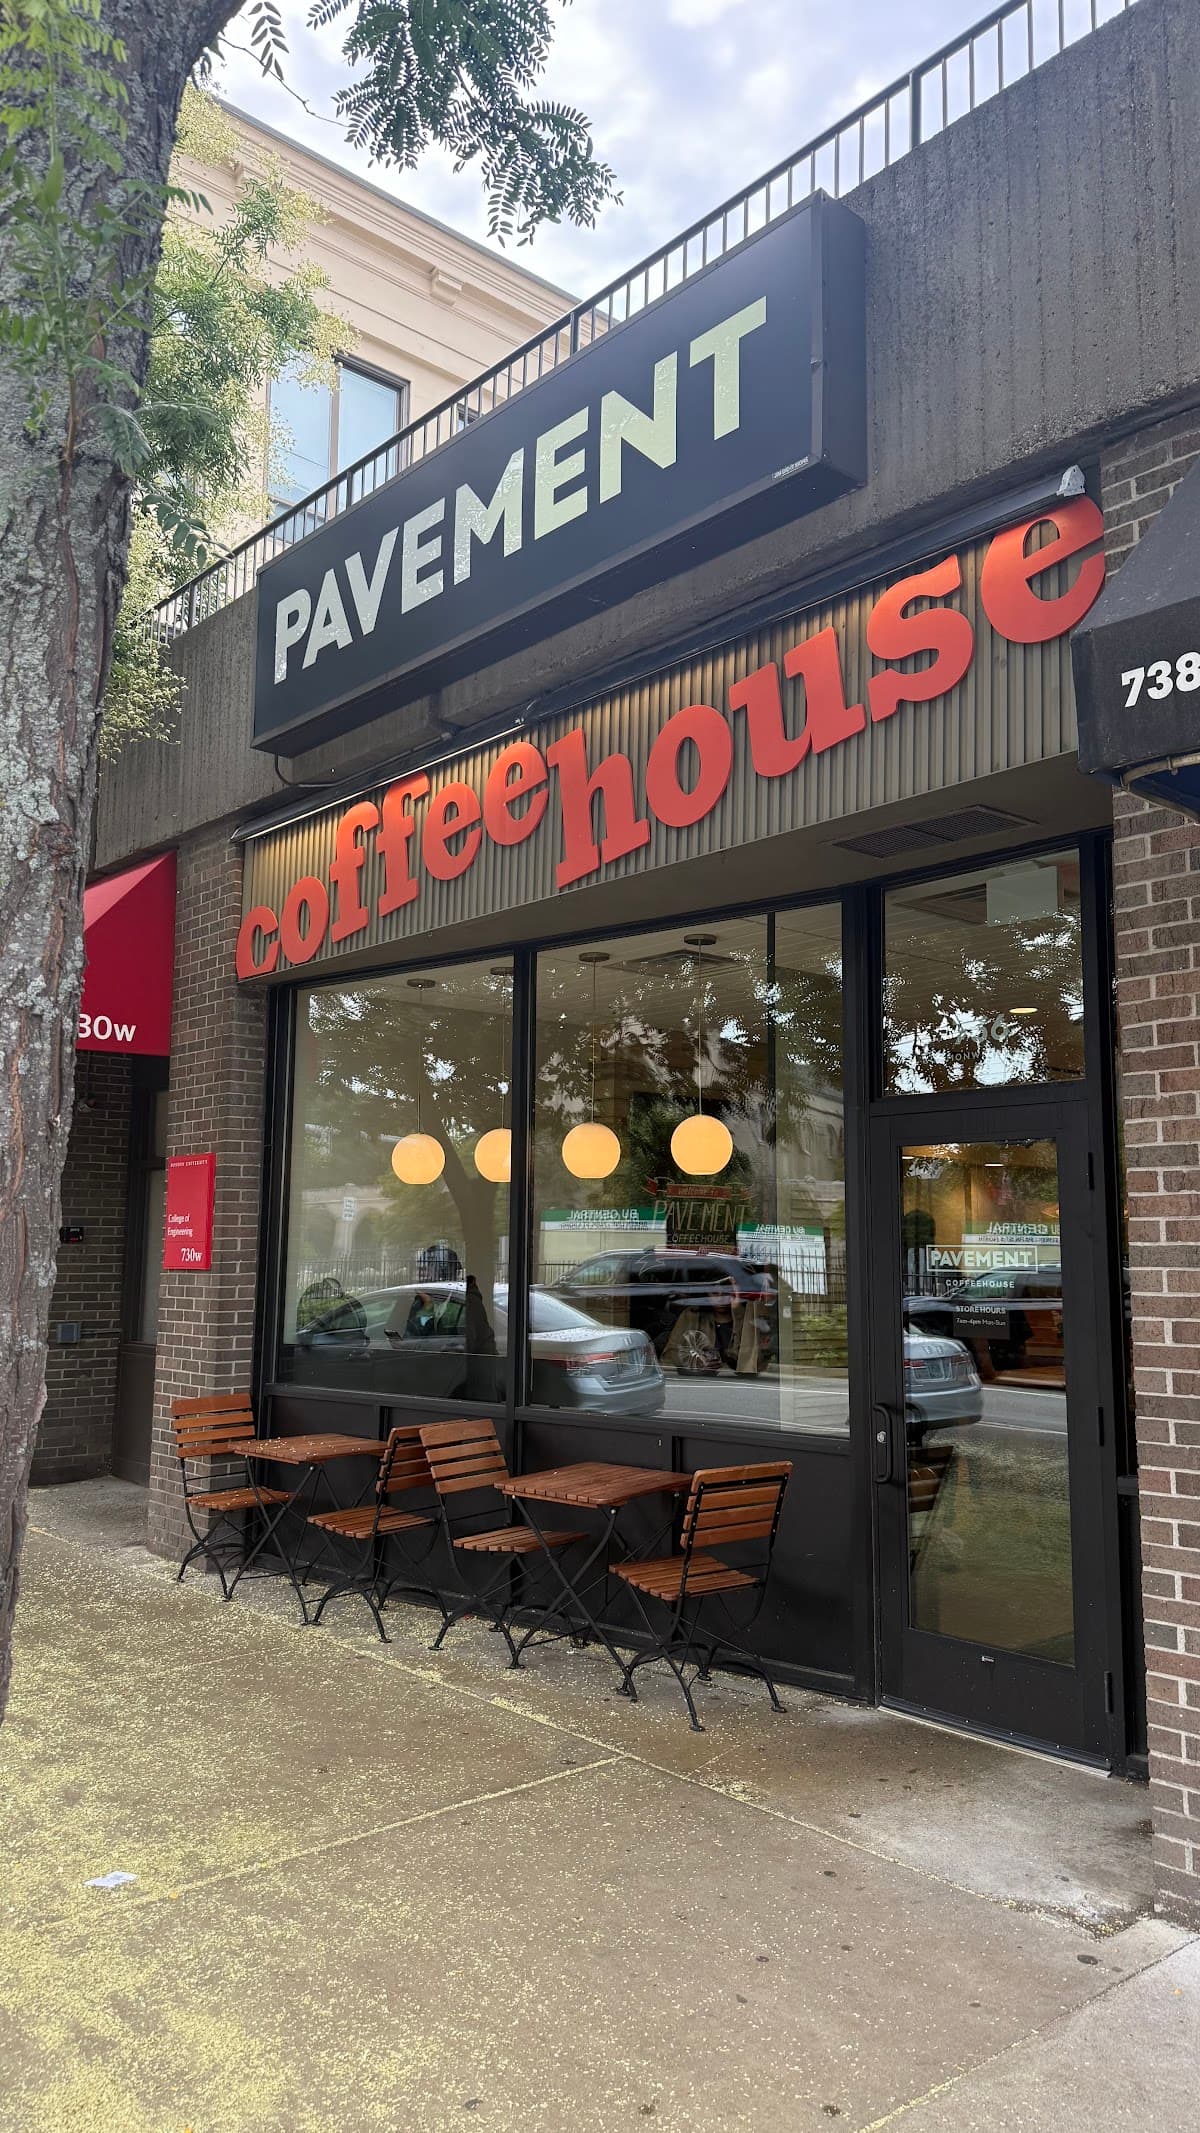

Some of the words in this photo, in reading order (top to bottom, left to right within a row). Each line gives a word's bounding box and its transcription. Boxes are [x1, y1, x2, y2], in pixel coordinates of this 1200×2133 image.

[274, 296, 768, 685] PAVEMENT
[1121, 651, 1200, 708] 738
[236, 495, 1107, 981] coffeehouse
[181, 1247, 203, 1262] 730w
[930, 1250, 1033, 1267] PAVEMENT
[945, 1279, 1015, 1289] COFFEEHOUSE
[980, 1306, 1006, 1314] HOURS
